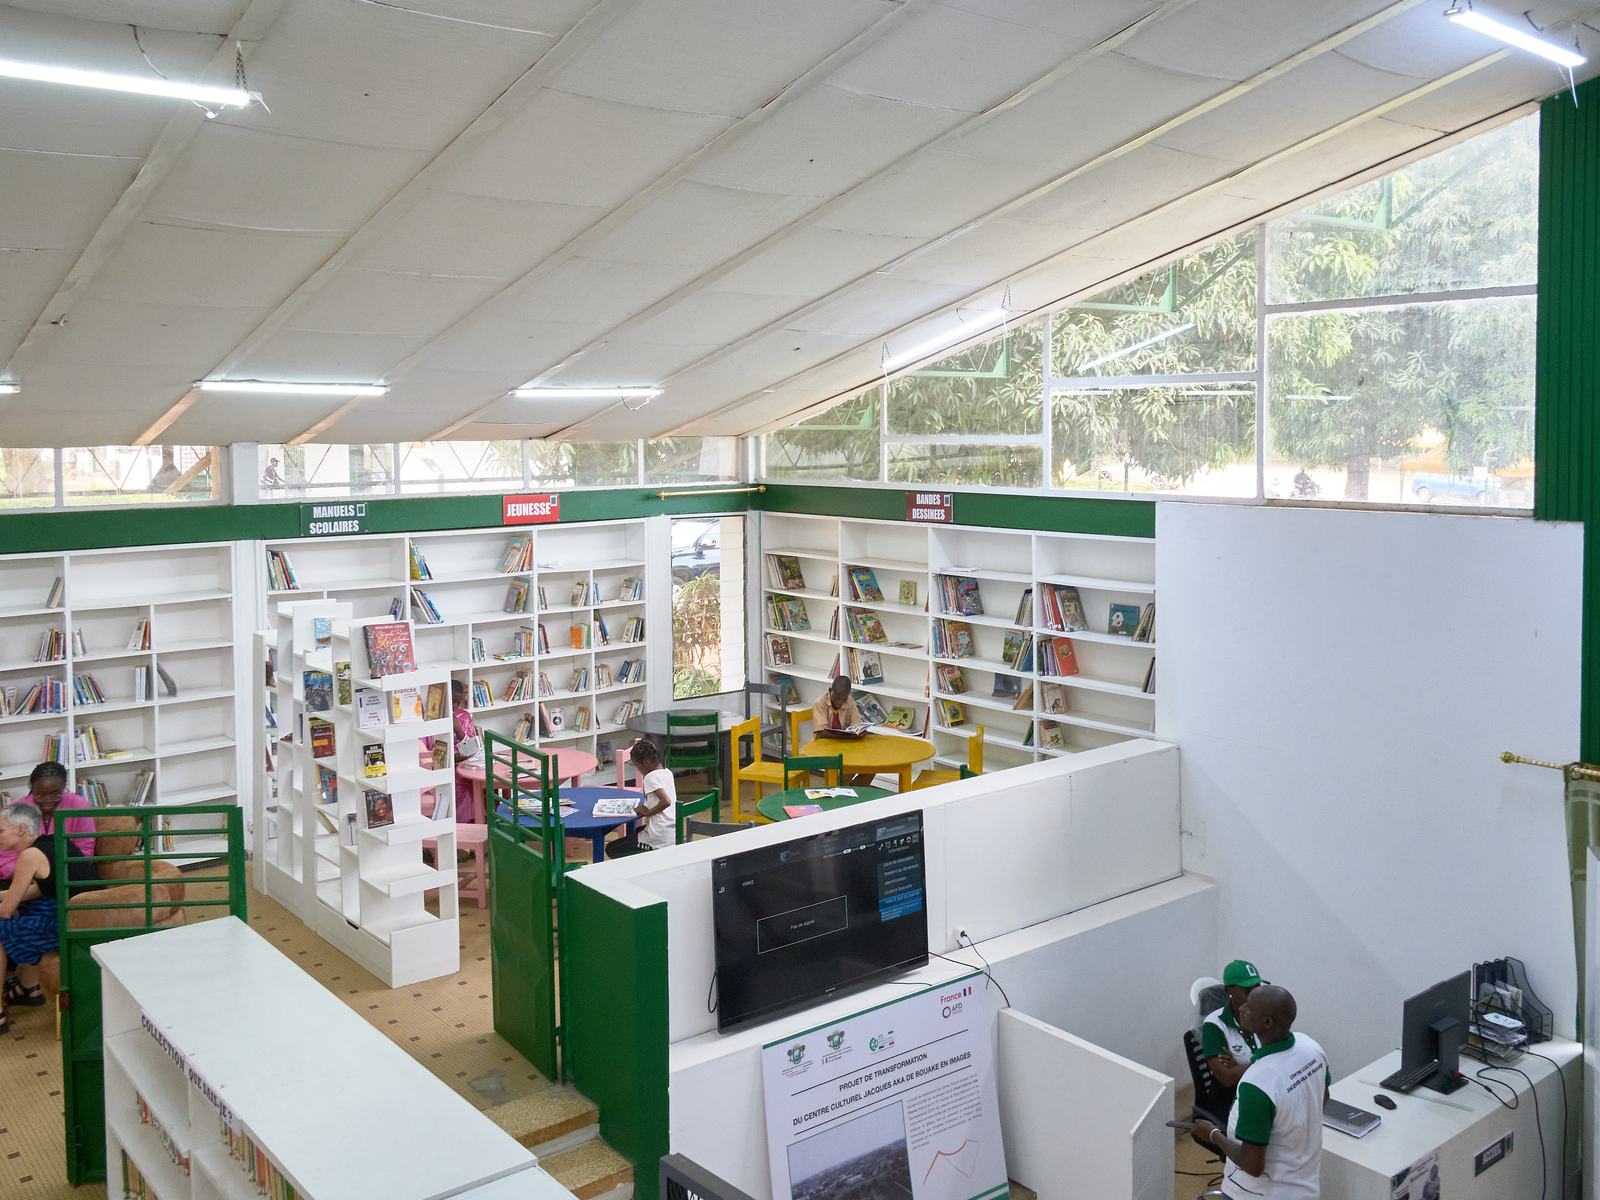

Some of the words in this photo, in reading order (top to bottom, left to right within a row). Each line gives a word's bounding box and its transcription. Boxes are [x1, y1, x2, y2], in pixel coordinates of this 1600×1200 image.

[916, 493, 941, 505] BANDES
[313, 504, 355, 519] MANUELS
[506, 502, 551, 517] JEUNESSE
[309, 520, 359, 535] SCOLAIRES
[940, 992, 962, 1004] France
[141, 1014, 185, 1072] COLLECTION
[188, 1068, 202, 1090] QUE
[839, 1076, 864, 1092] PROJET
[864, 1073, 873, 1082] DE
[874, 1052, 928, 1078] TRANSFORMATION
[792, 1116, 803, 1126] DU
[803, 1105, 830, 1122] CENTRE
[830, 1093, 863, 1111] CULTUREL
[863, 1081, 892, 1098] JACQUES
[892, 1076, 906, 1087] AKA
[906, 1072, 915, 1082] DE
[915, 1062, 940, 1078] BOUAKE
[940, 1059, 949, 1068] EN
[949, 1051, 972, 1065] IMAGES
